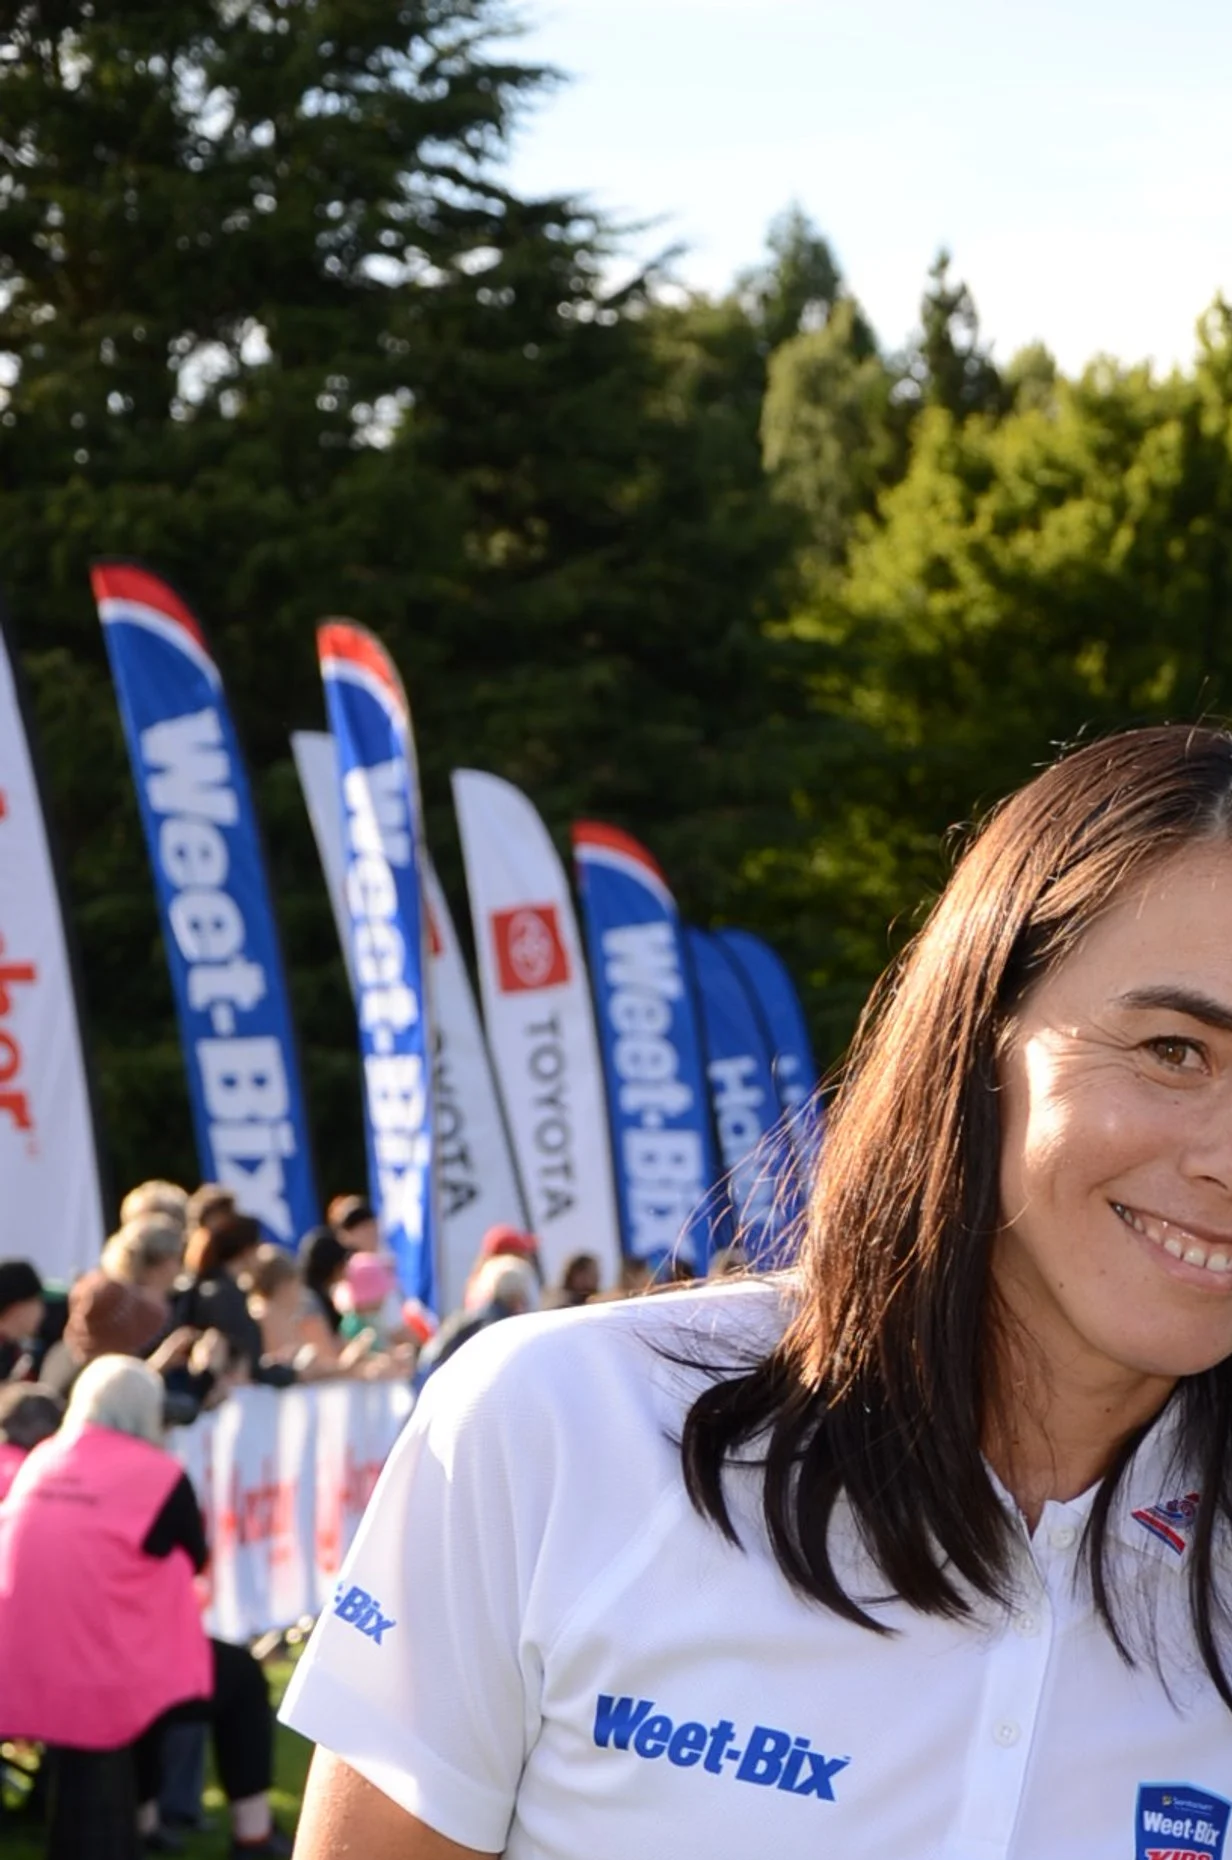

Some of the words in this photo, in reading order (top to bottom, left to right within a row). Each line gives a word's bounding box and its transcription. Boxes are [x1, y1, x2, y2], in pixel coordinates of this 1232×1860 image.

[141, 706, 297, 1245] Weet-Bix
[524, 1009, 574, 1222] TOYOTA
[602, 921, 705, 1262] Weet-Bix
[594, 1693, 851, 1802] Weet-Bix
[1142, 1810, 1221, 1847] Weet-Bix
